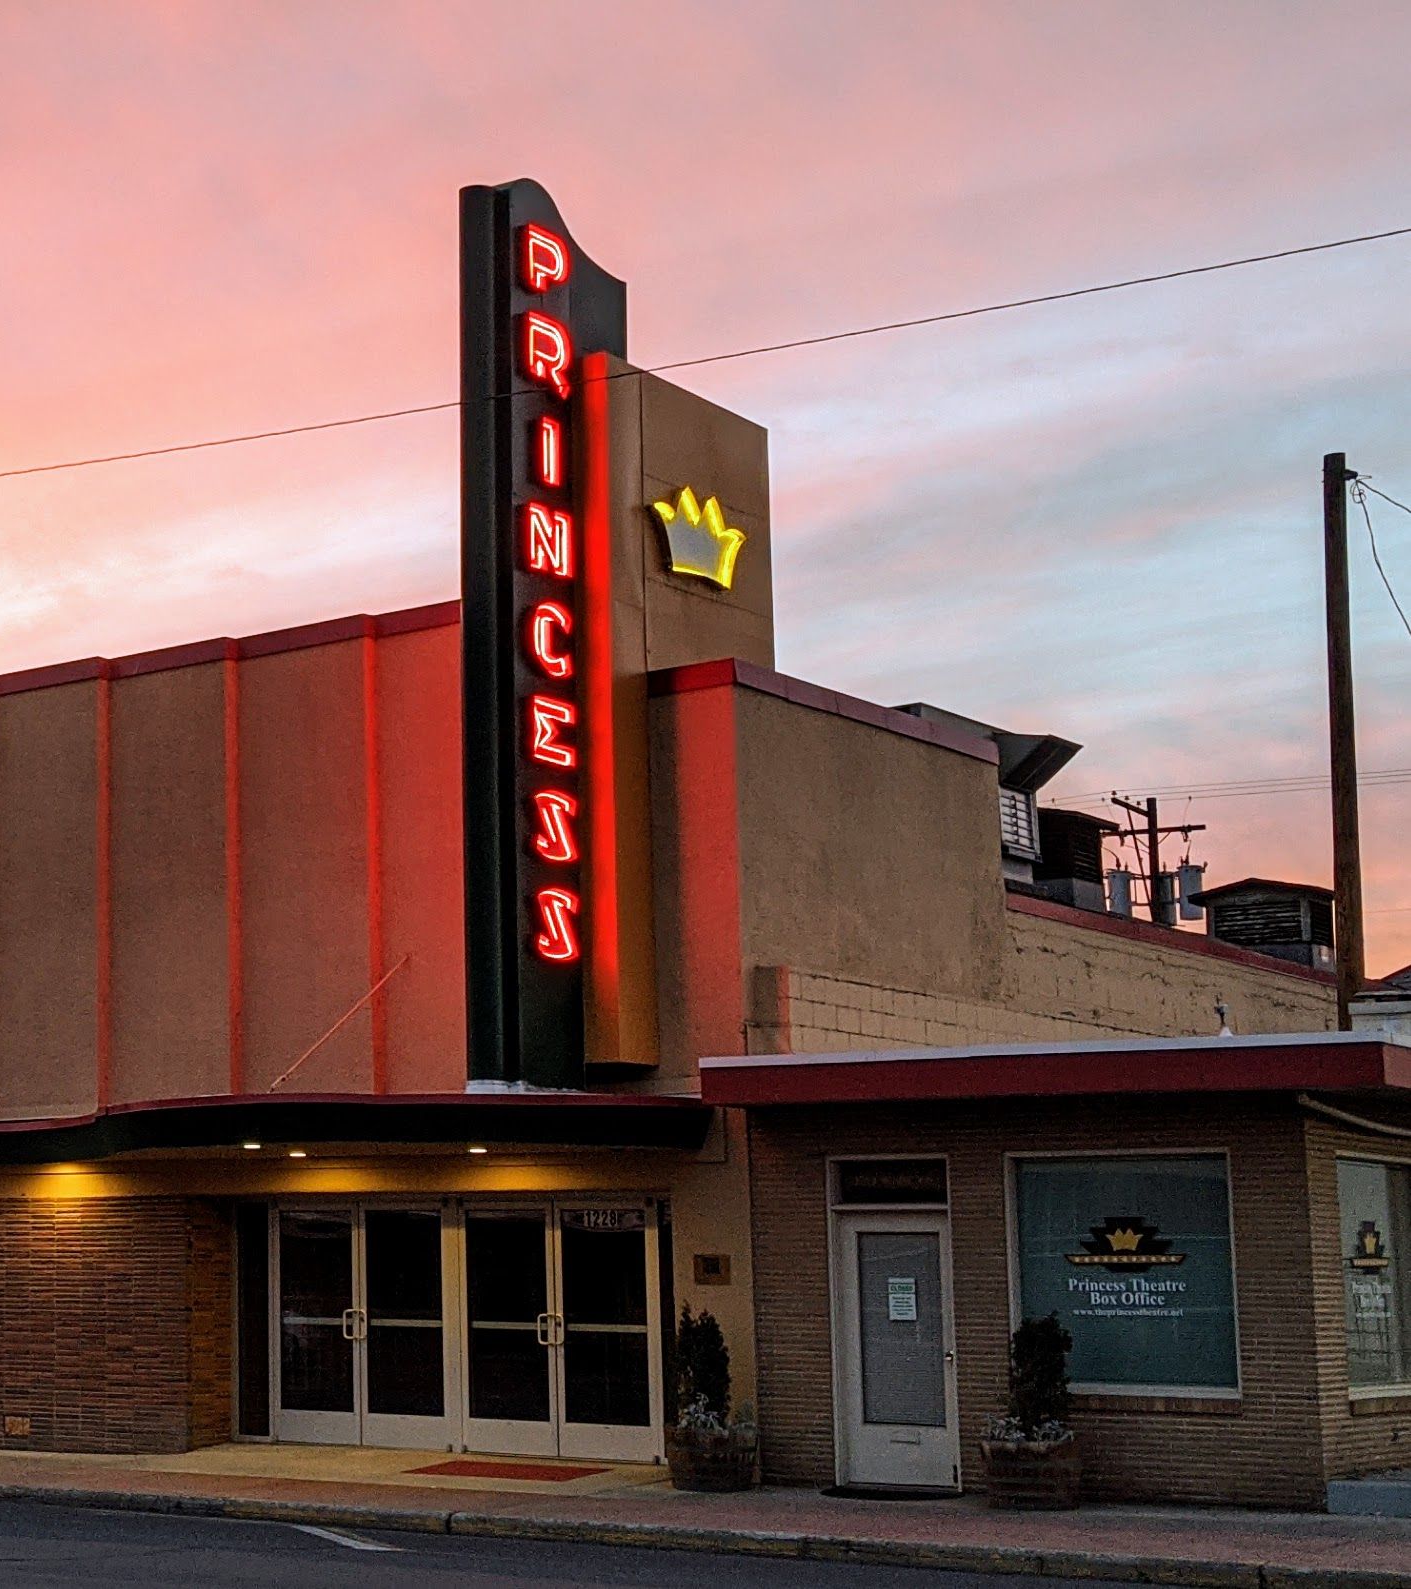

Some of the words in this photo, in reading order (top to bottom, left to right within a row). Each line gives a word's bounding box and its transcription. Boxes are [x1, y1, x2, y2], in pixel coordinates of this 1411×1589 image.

[524, 223, 580, 963] PRINCESS
[1068, 1278, 1126, 1292] Princess
[1128, 1278, 1187, 1292] Theatre
[1090, 1292, 1118, 1305] Box
[1121, 1291, 1165, 1305] Office
